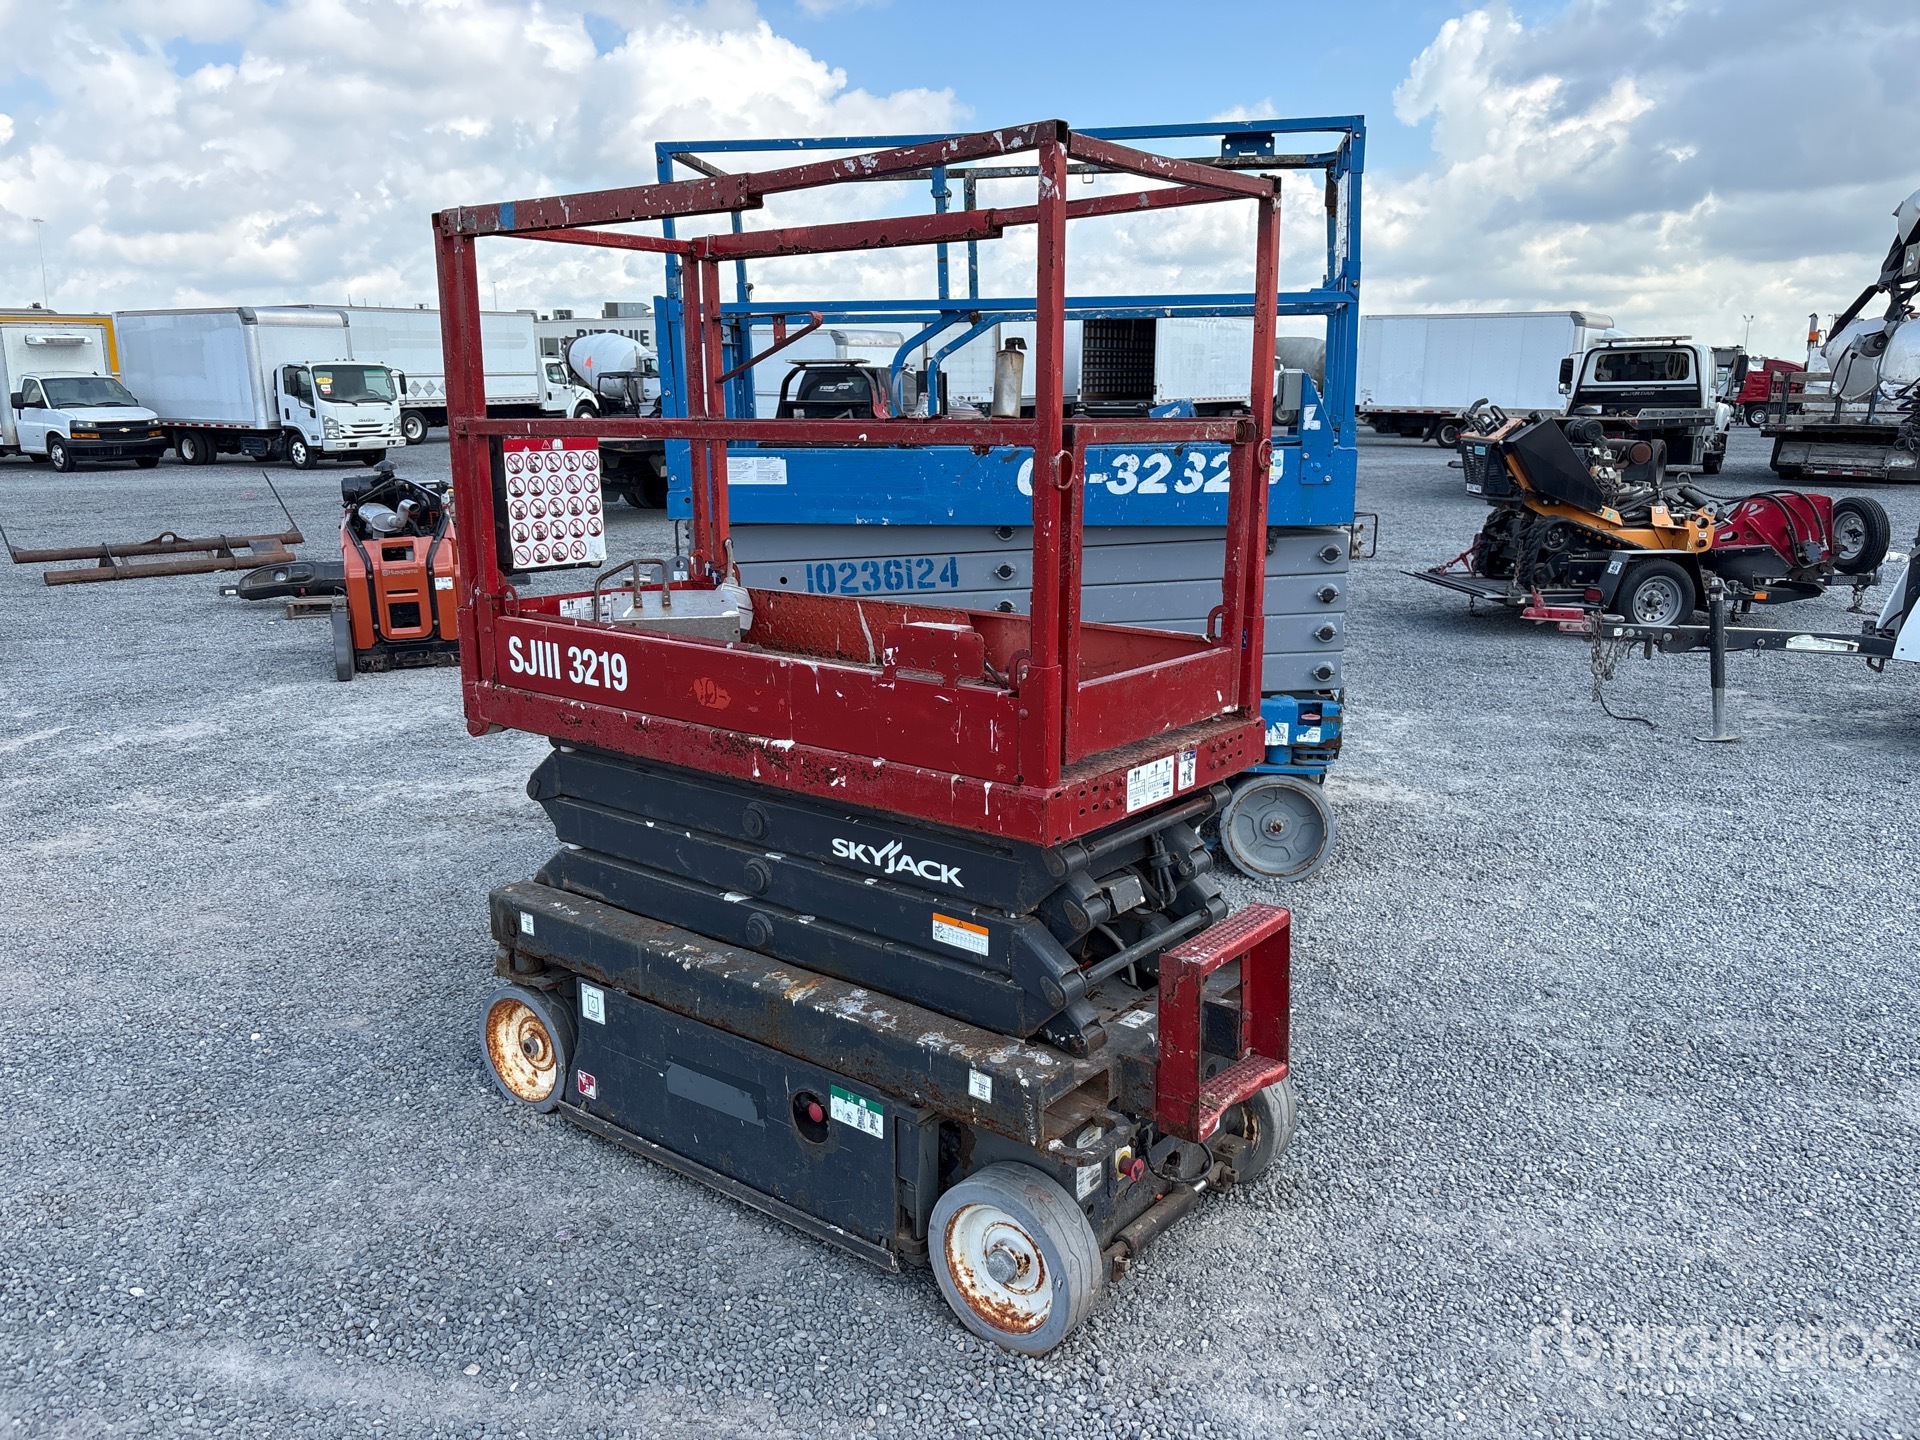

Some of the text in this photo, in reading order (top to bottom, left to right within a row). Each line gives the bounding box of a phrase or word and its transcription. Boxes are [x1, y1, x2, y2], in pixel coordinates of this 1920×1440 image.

[1017, 452, 1231, 496] -3232
[388, 568, 419, 576] Husqvarna
[806, 556, 960, 594] 10236124
[508, 635, 629, 692] SJIII 3219
[831, 837, 965, 889] SKYJACK
